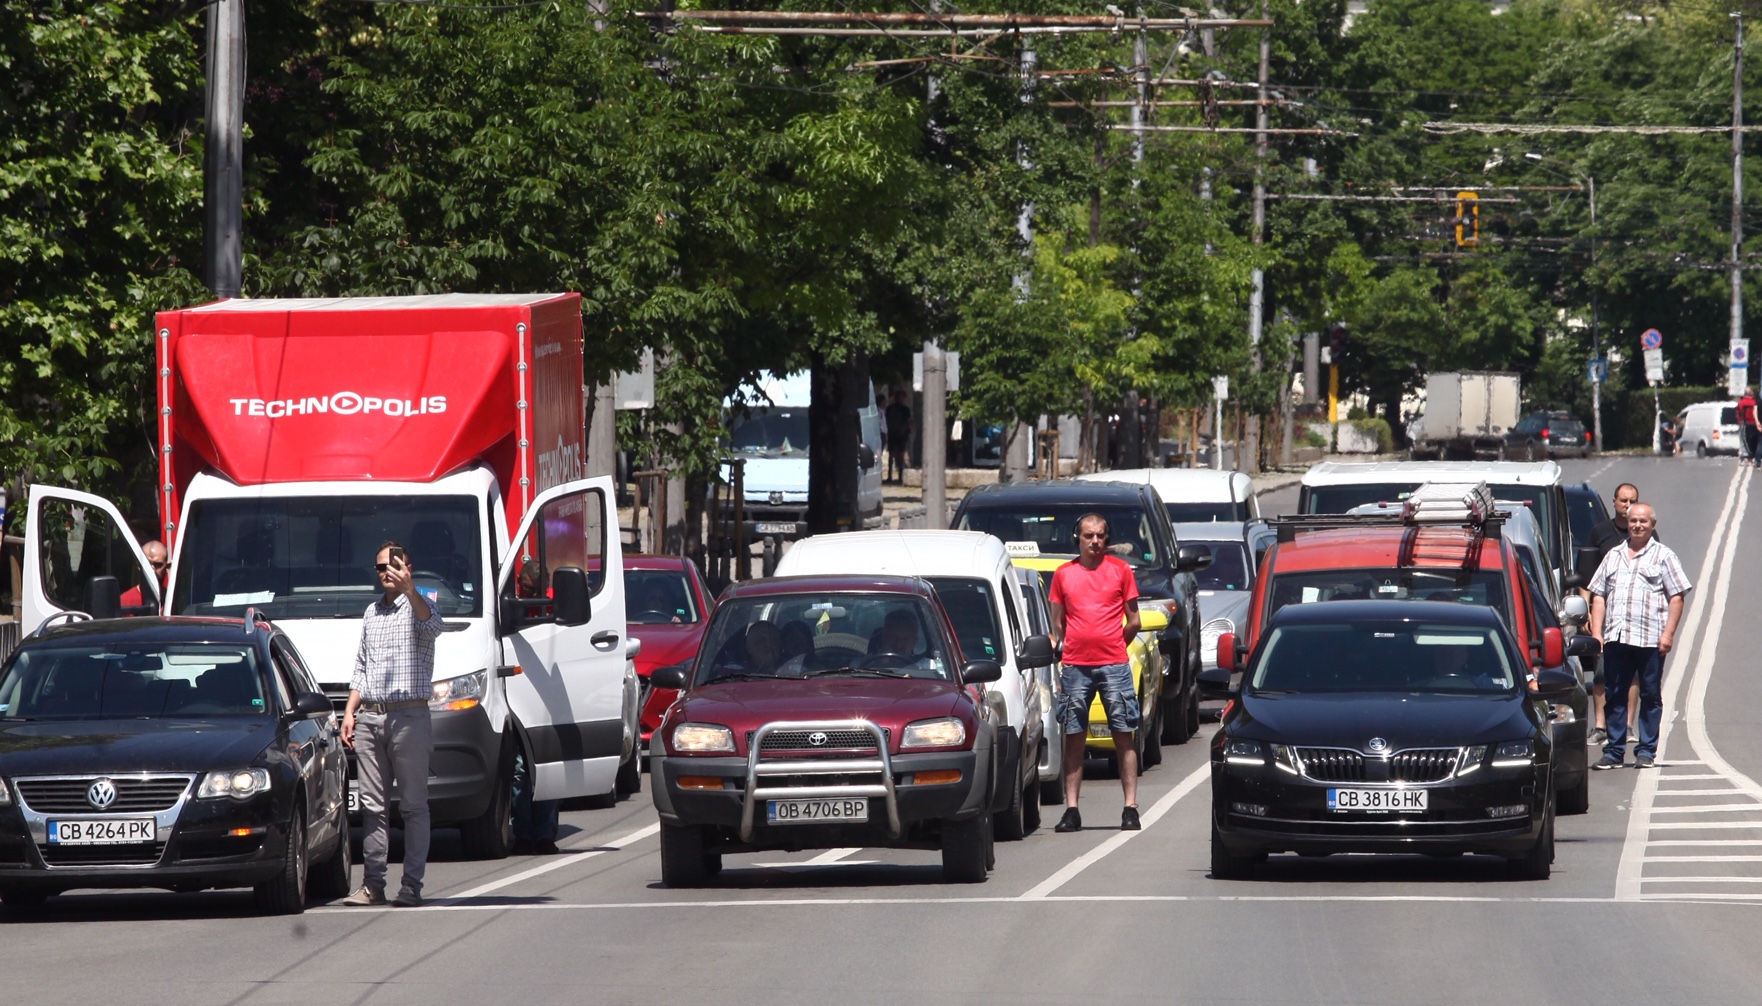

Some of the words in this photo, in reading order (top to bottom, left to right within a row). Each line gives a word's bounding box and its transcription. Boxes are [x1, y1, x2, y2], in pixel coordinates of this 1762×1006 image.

[229, 391, 447, 418] TECHNOPOLIS
[1339, 791, 1359, 807] CB
[1363, 791, 1400, 807] 3816
[1404, 791, 1424, 807] HK
[779, 803, 800, 818] OB
[803, 802, 841, 817] 4706
[844, 801, 864, 816] BP
[60, 823, 82, 840] CB
[86, 822, 126, 839] 4264
[130, 821, 151, 838] PK
